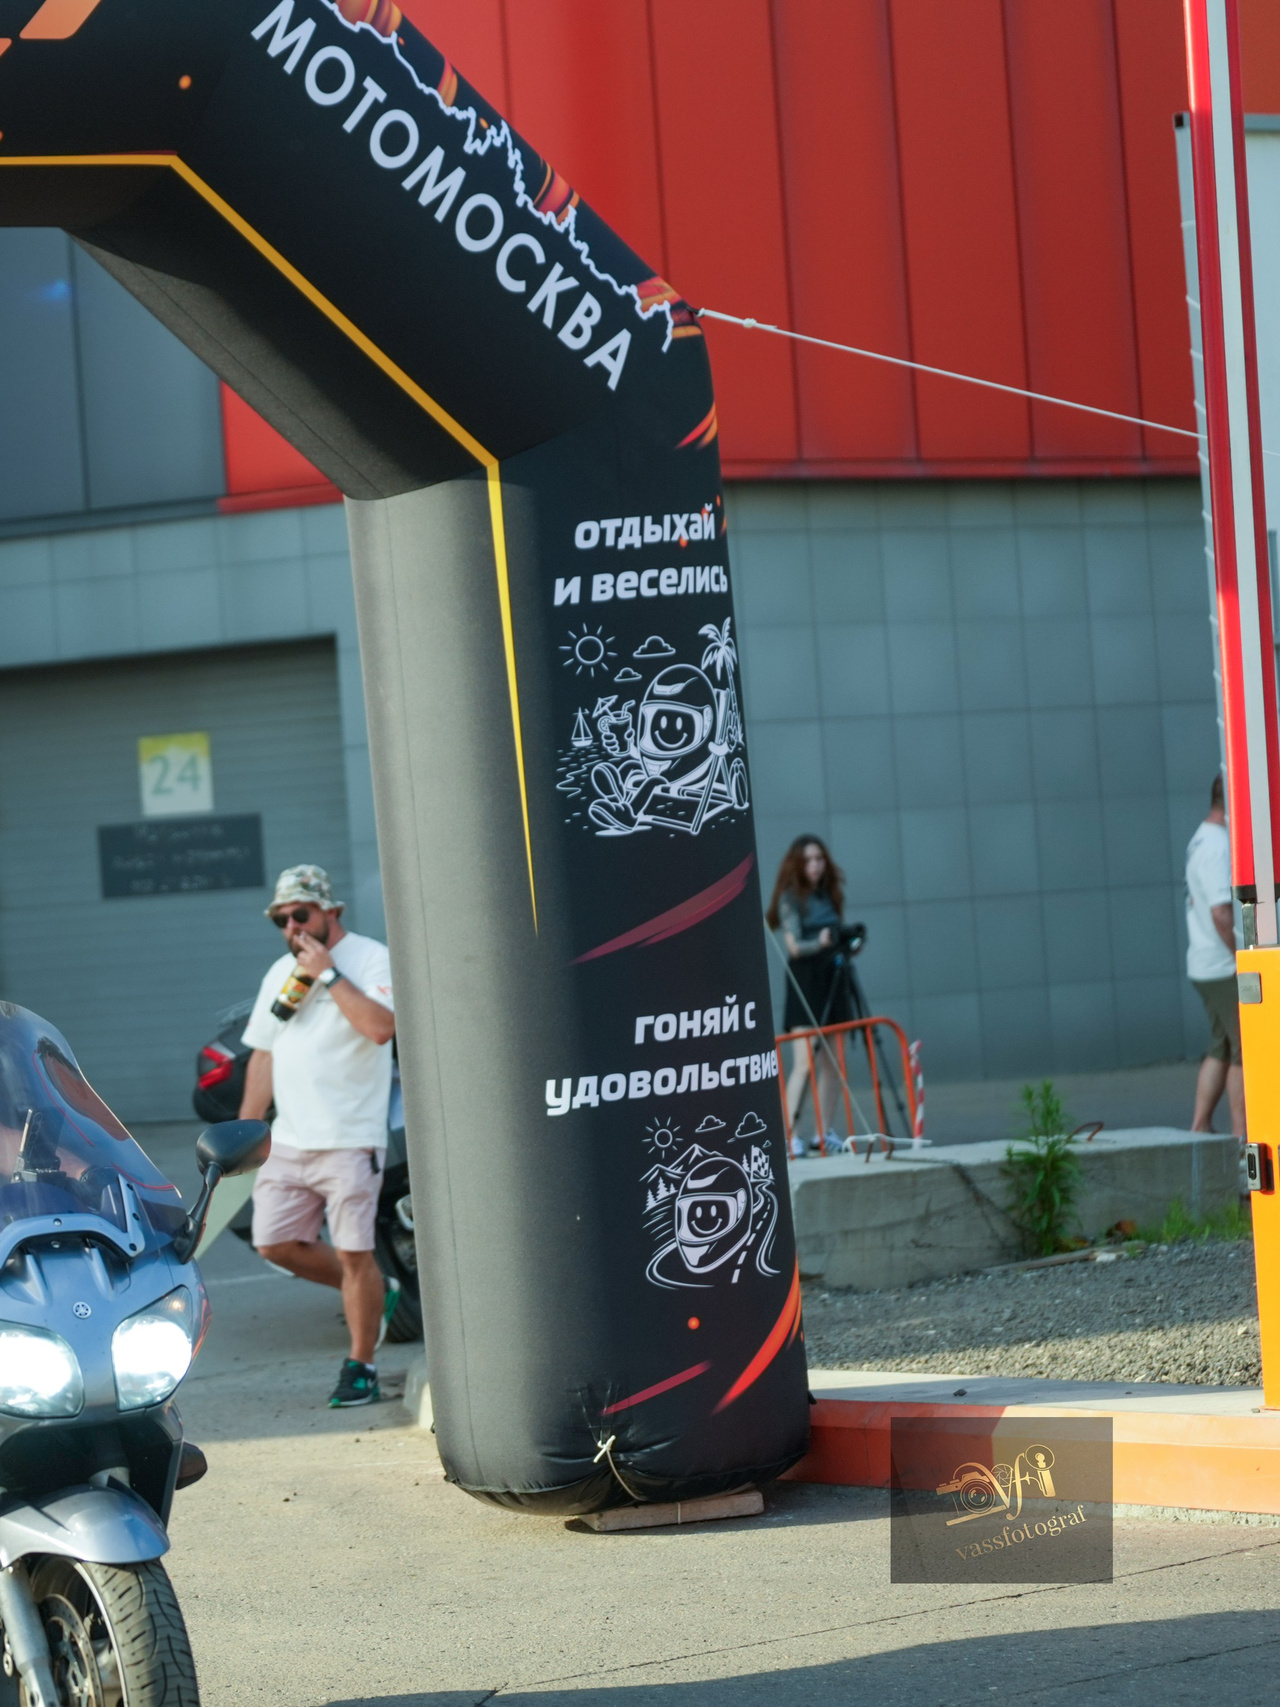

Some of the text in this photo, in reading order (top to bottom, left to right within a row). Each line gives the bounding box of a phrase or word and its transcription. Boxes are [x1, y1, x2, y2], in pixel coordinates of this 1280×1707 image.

[250, 0, 632, 391] МОТОМОСКВА
[574, 502, 716, 550] отдыхай
[553, 565, 728, 607] и веселись
[150, 753, 203, 796] 24
[634, 994, 740, 1045] гоняй
